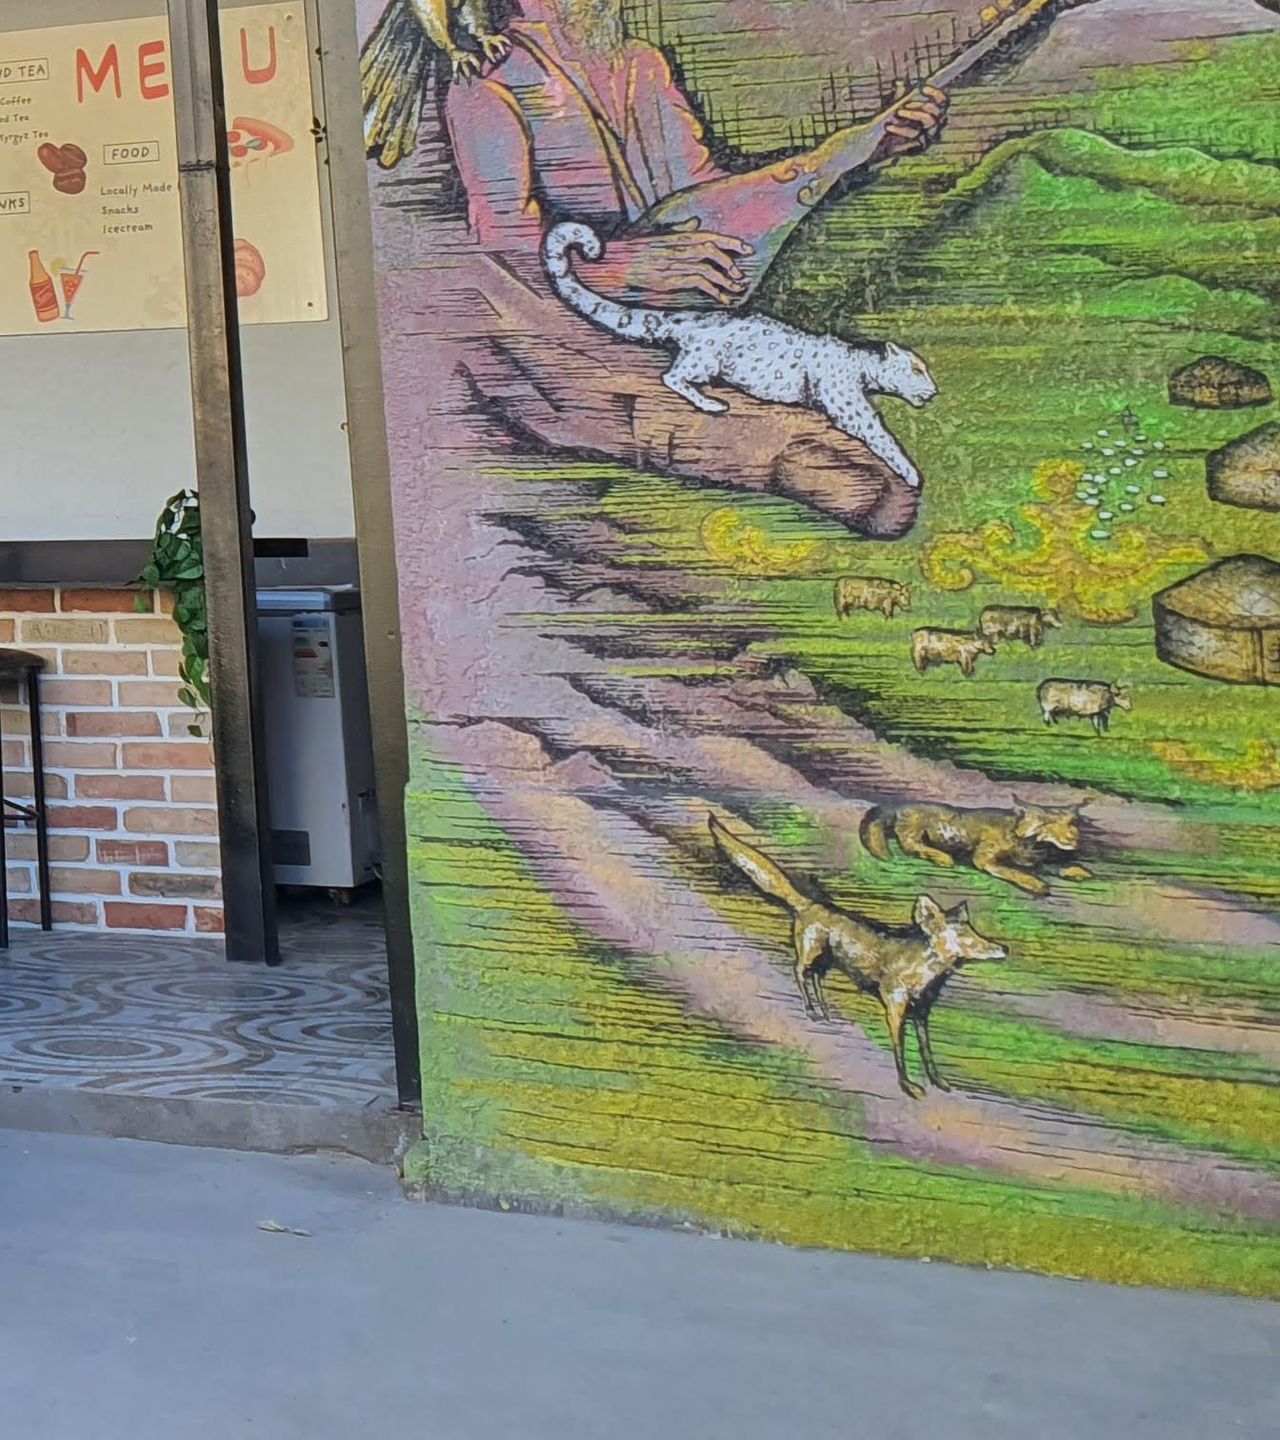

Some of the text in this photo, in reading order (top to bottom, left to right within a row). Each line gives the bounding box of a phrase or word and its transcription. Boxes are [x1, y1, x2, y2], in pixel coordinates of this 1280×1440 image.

[76, 25, 278, 104] MEU
[18, 64, 46, 77] TEA
[0, 95, 32, 106] Coffee
[14, 113, 30, 122] Tea
[32, 130, 49, 139] Tea
[111, 146, 150, 160] FOOD
[100, 182, 172, 198] Locally Made
[101, 204, 139, 215] Snacks
[102, 223, 153, 234] Icecream
